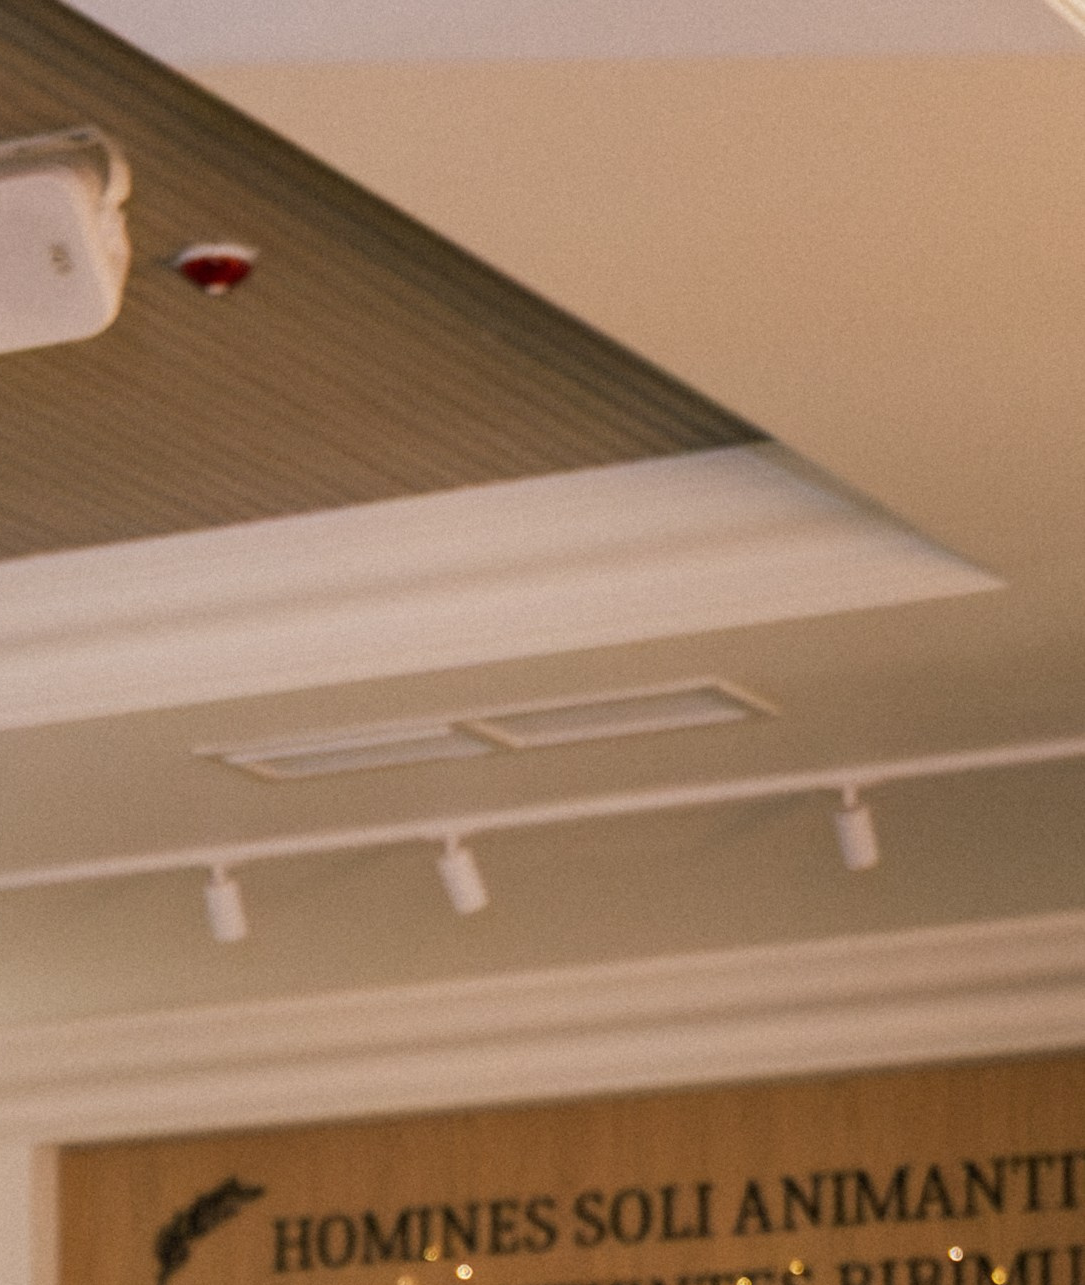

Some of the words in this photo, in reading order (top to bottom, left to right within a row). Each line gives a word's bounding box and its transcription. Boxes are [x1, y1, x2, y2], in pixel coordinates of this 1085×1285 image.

[273, 1198, 557, 1273] HOMINES
[573, 1183, 713, 1246] SOLI
[734, 1151, 1085, 1236] ANIMANTI
